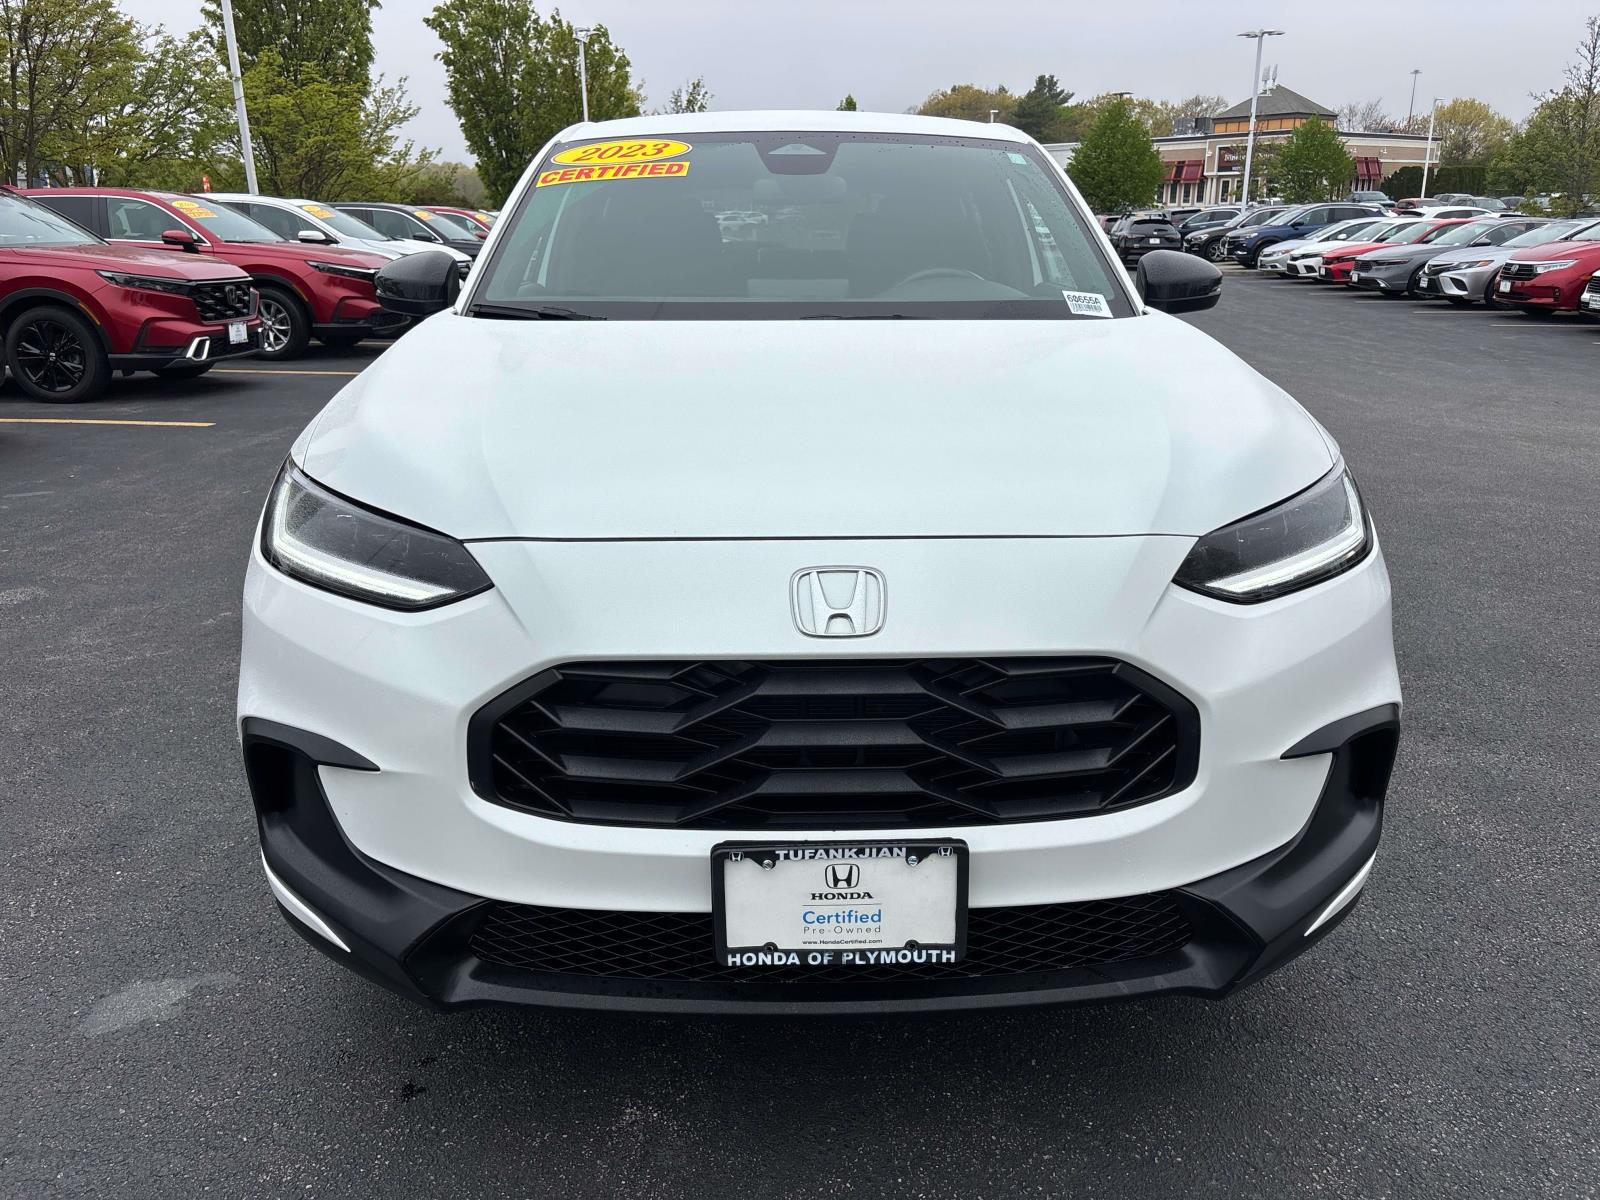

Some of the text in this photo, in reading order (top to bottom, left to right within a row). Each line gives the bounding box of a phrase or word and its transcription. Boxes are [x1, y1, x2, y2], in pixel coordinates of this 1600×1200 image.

[572, 142, 671, 163] 2023
[540, 163, 685, 185] CERTIFIED
[775, 847, 907, 861] TUFANKJIAN
[810, 891, 874, 901] HONDA
[802, 909, 882, 924] Certified
[803, 925, 882, 935] Pre-Owned
[802, 938, 883, 946] www.HondaCertified.com
[727, 950, 956, 967] HONDA OF PLYMOUTH
